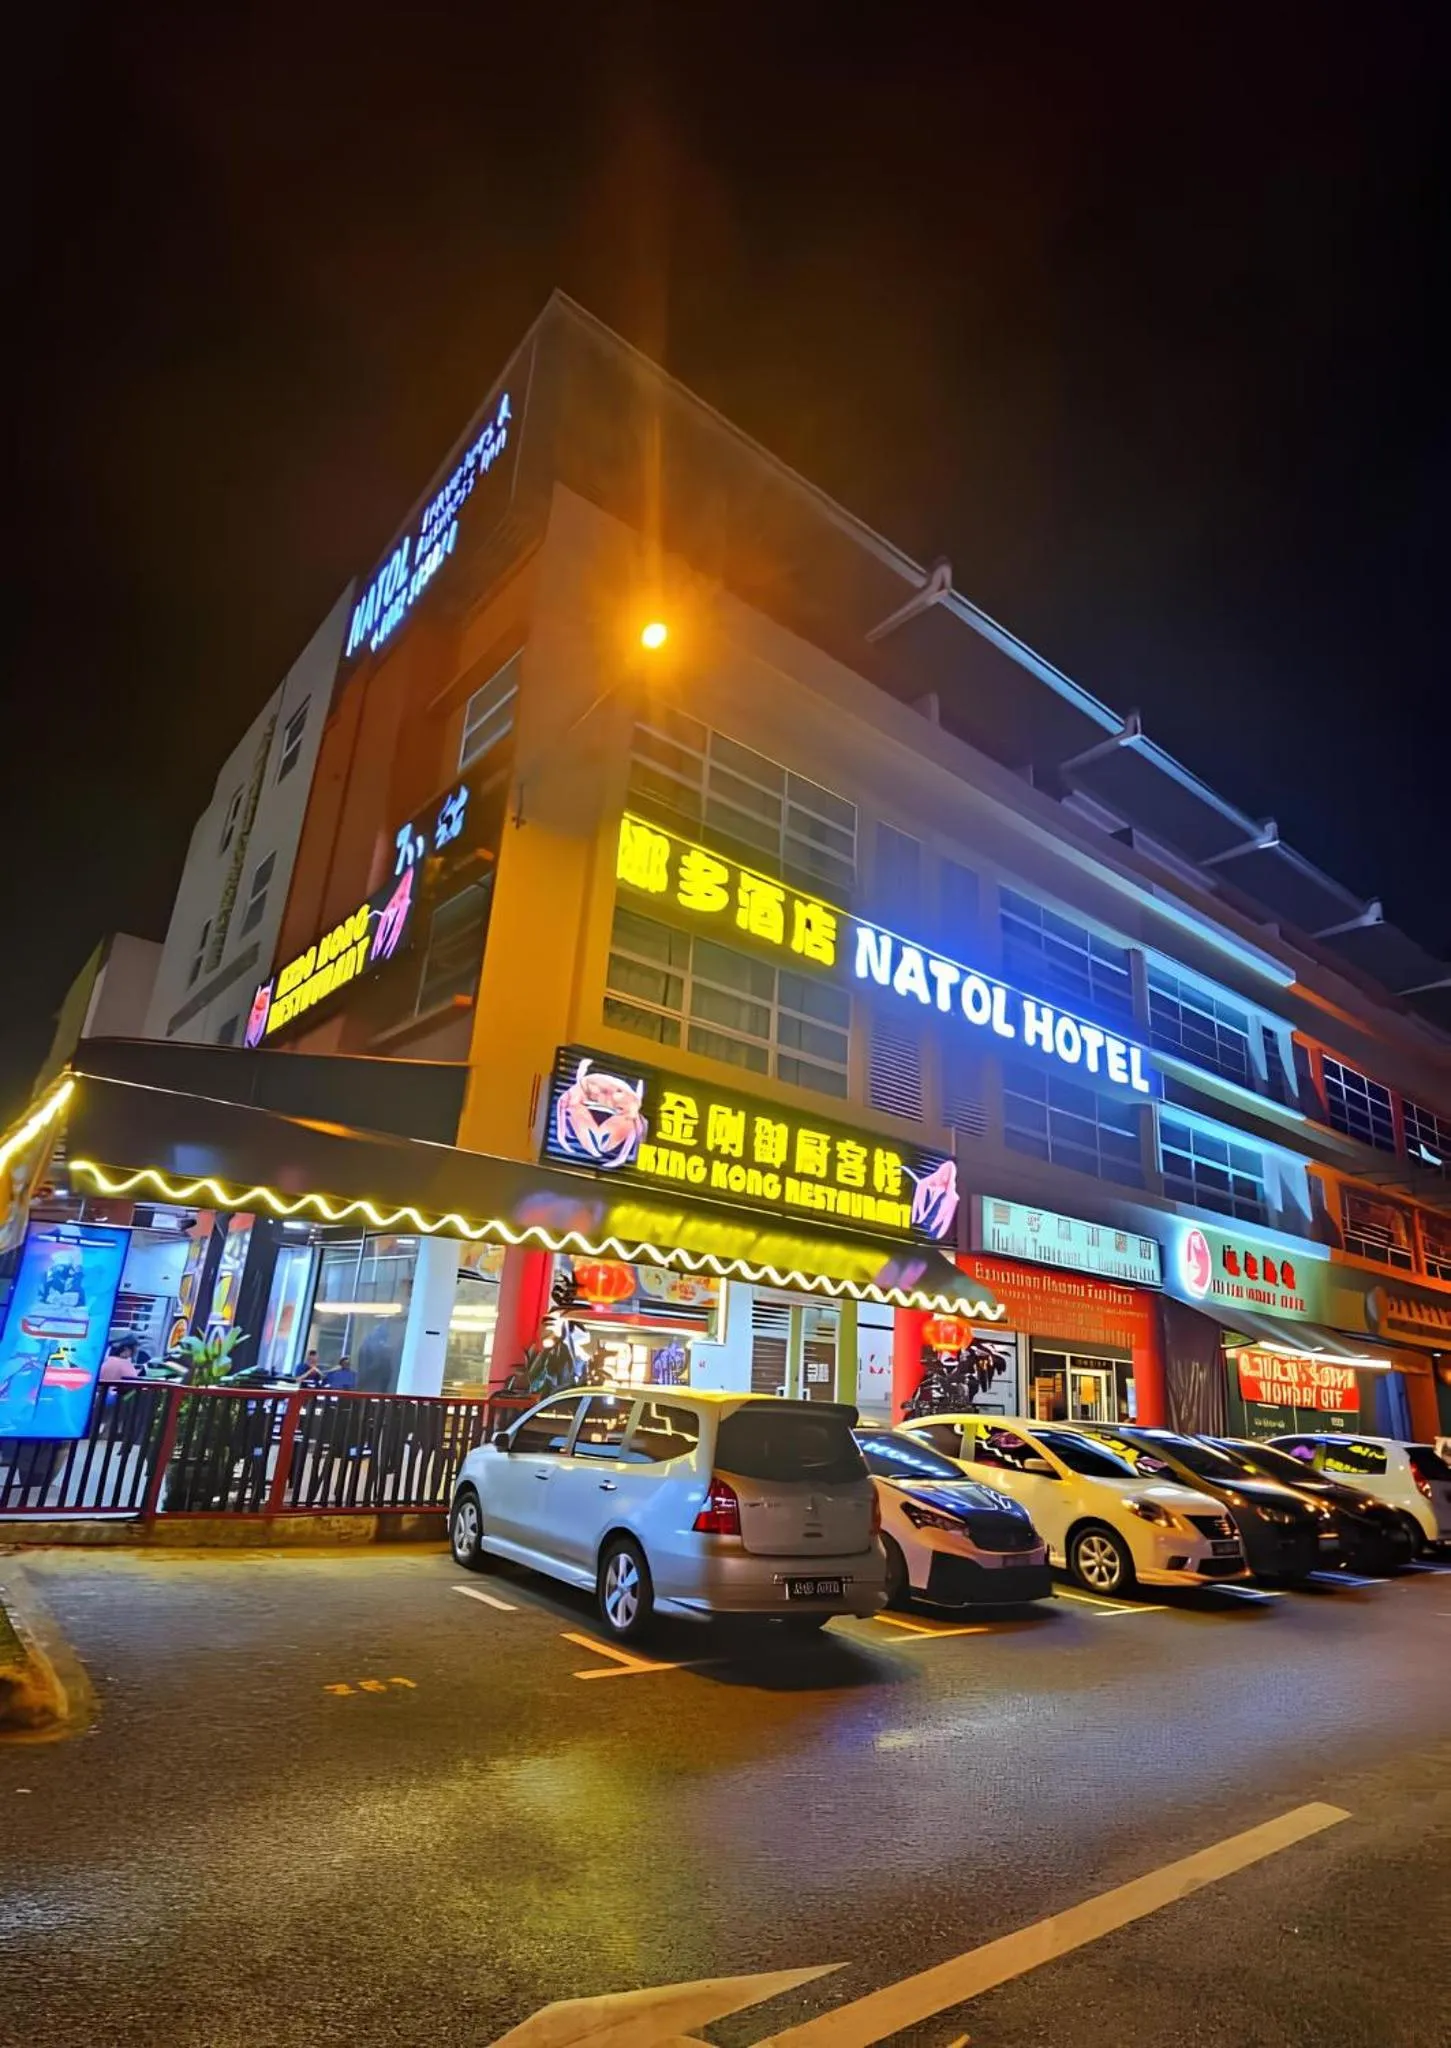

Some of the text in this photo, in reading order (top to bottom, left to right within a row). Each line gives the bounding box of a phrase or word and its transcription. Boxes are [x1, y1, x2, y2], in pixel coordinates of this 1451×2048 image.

[346, 536, 410, 657] NATOL
[855, 926, 1150, 1093] NATOL HOTEL
[636, 1143, 708, 1184] KING
[710, 1160, 783, 1200] KONG
